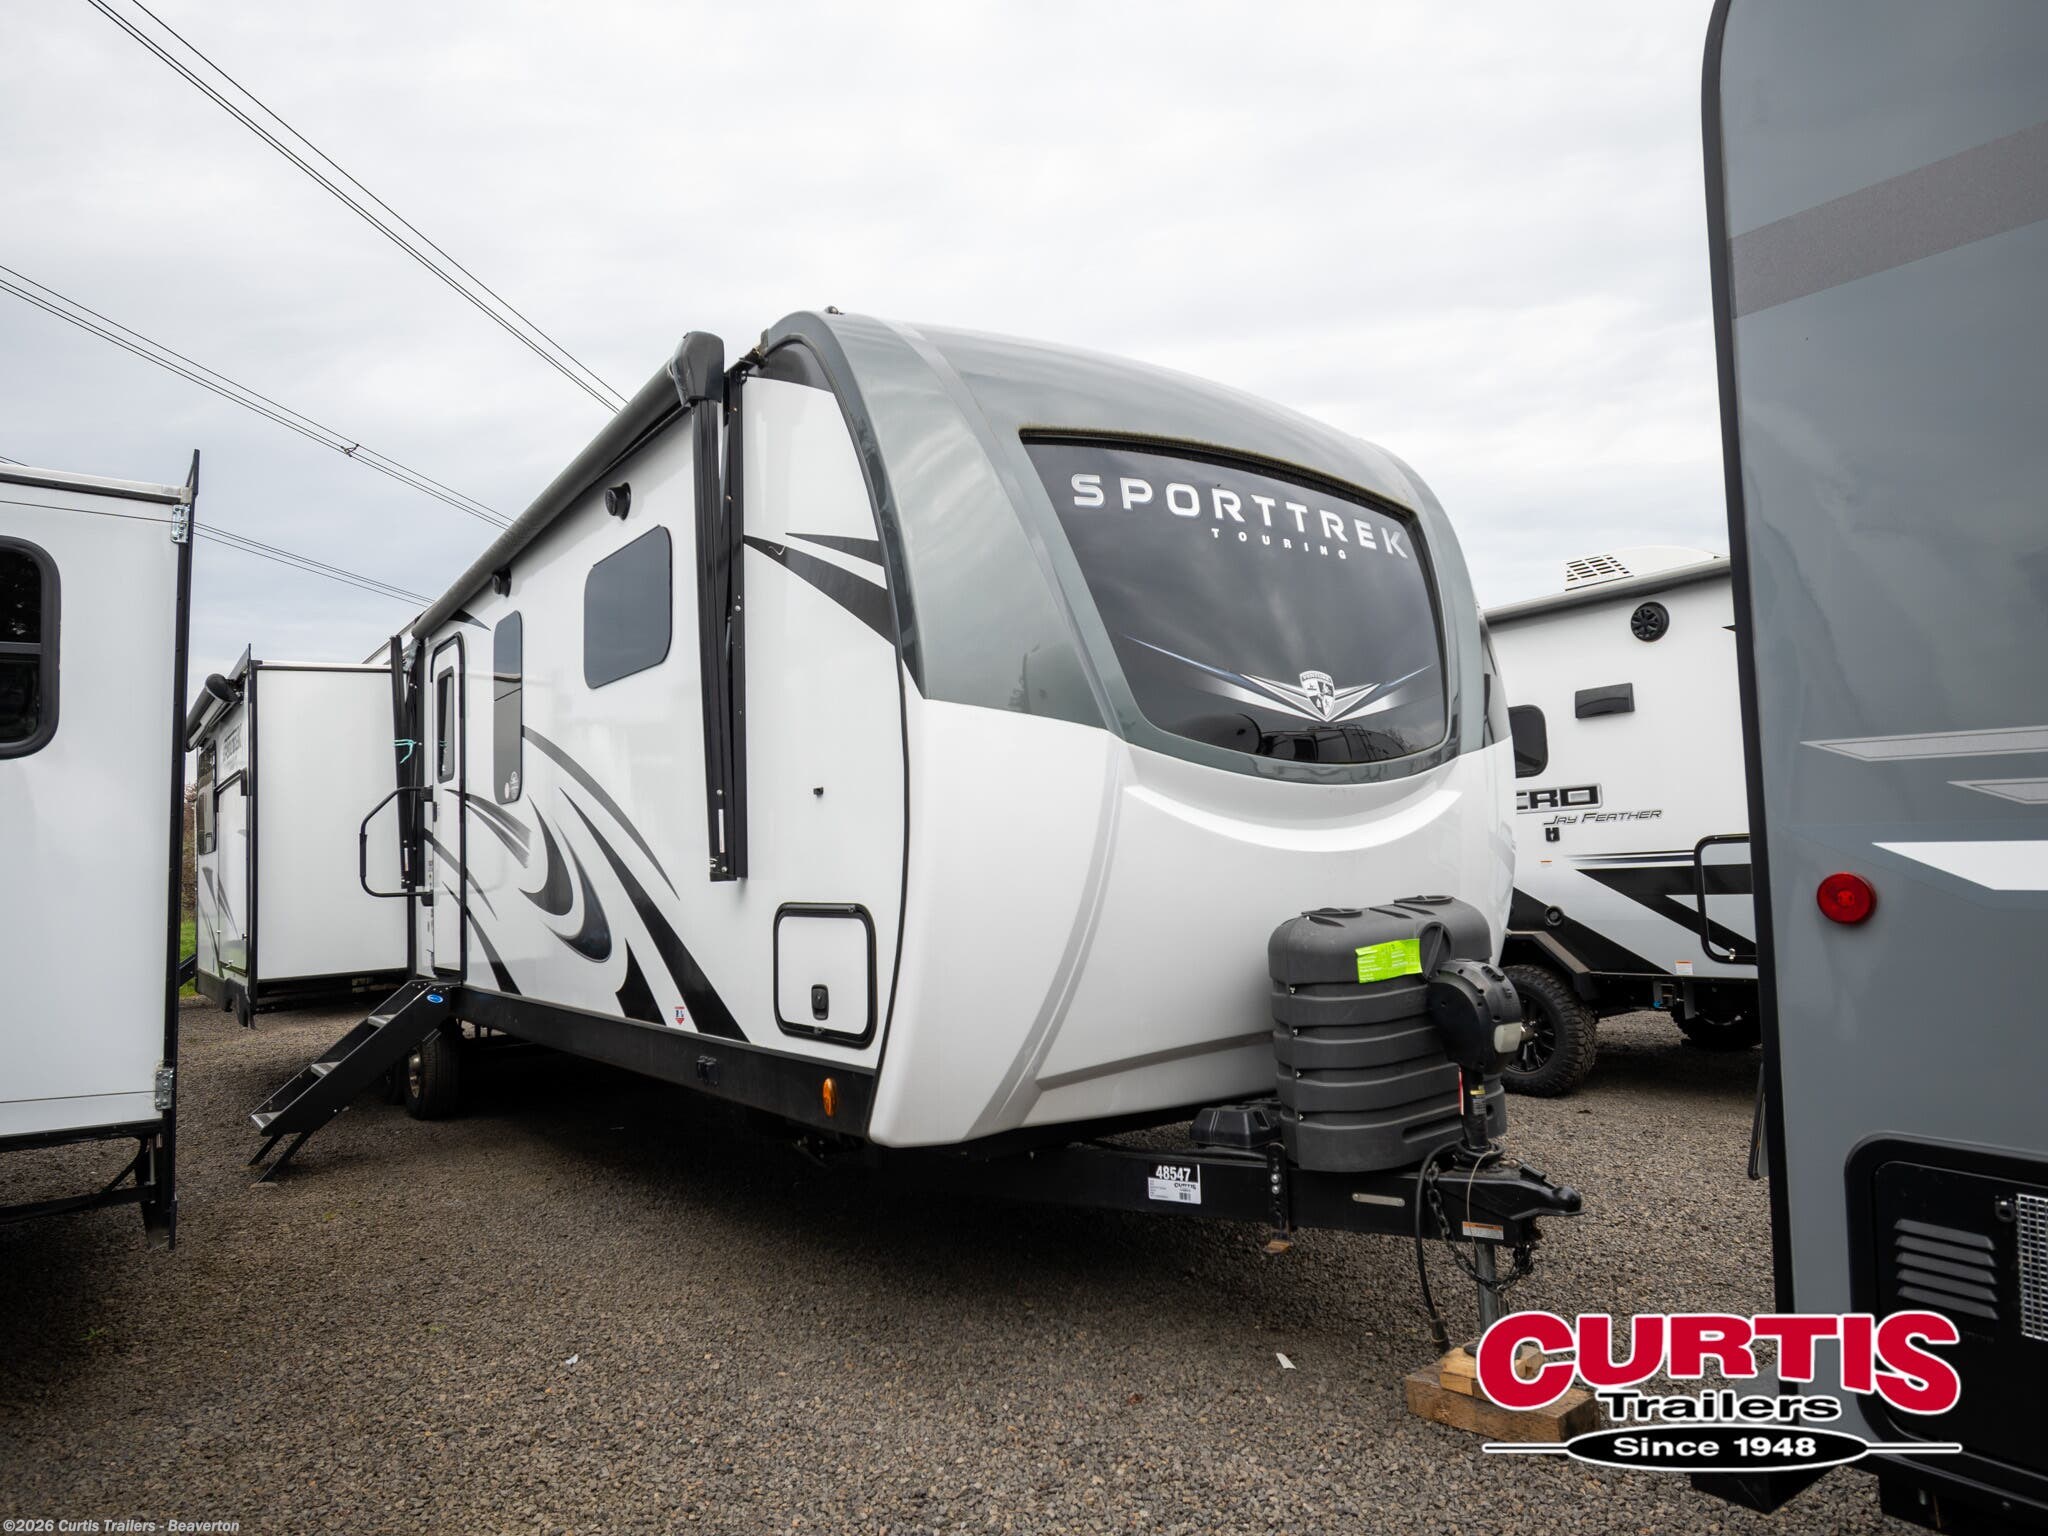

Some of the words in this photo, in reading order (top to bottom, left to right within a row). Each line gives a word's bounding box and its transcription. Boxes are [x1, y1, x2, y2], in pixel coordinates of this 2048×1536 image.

[1071, 473, 1408, 559] SPORTTREK
[1211, 527, 1347, 560] TOURING
[1155, 1165, 1191, 1182] 48547
